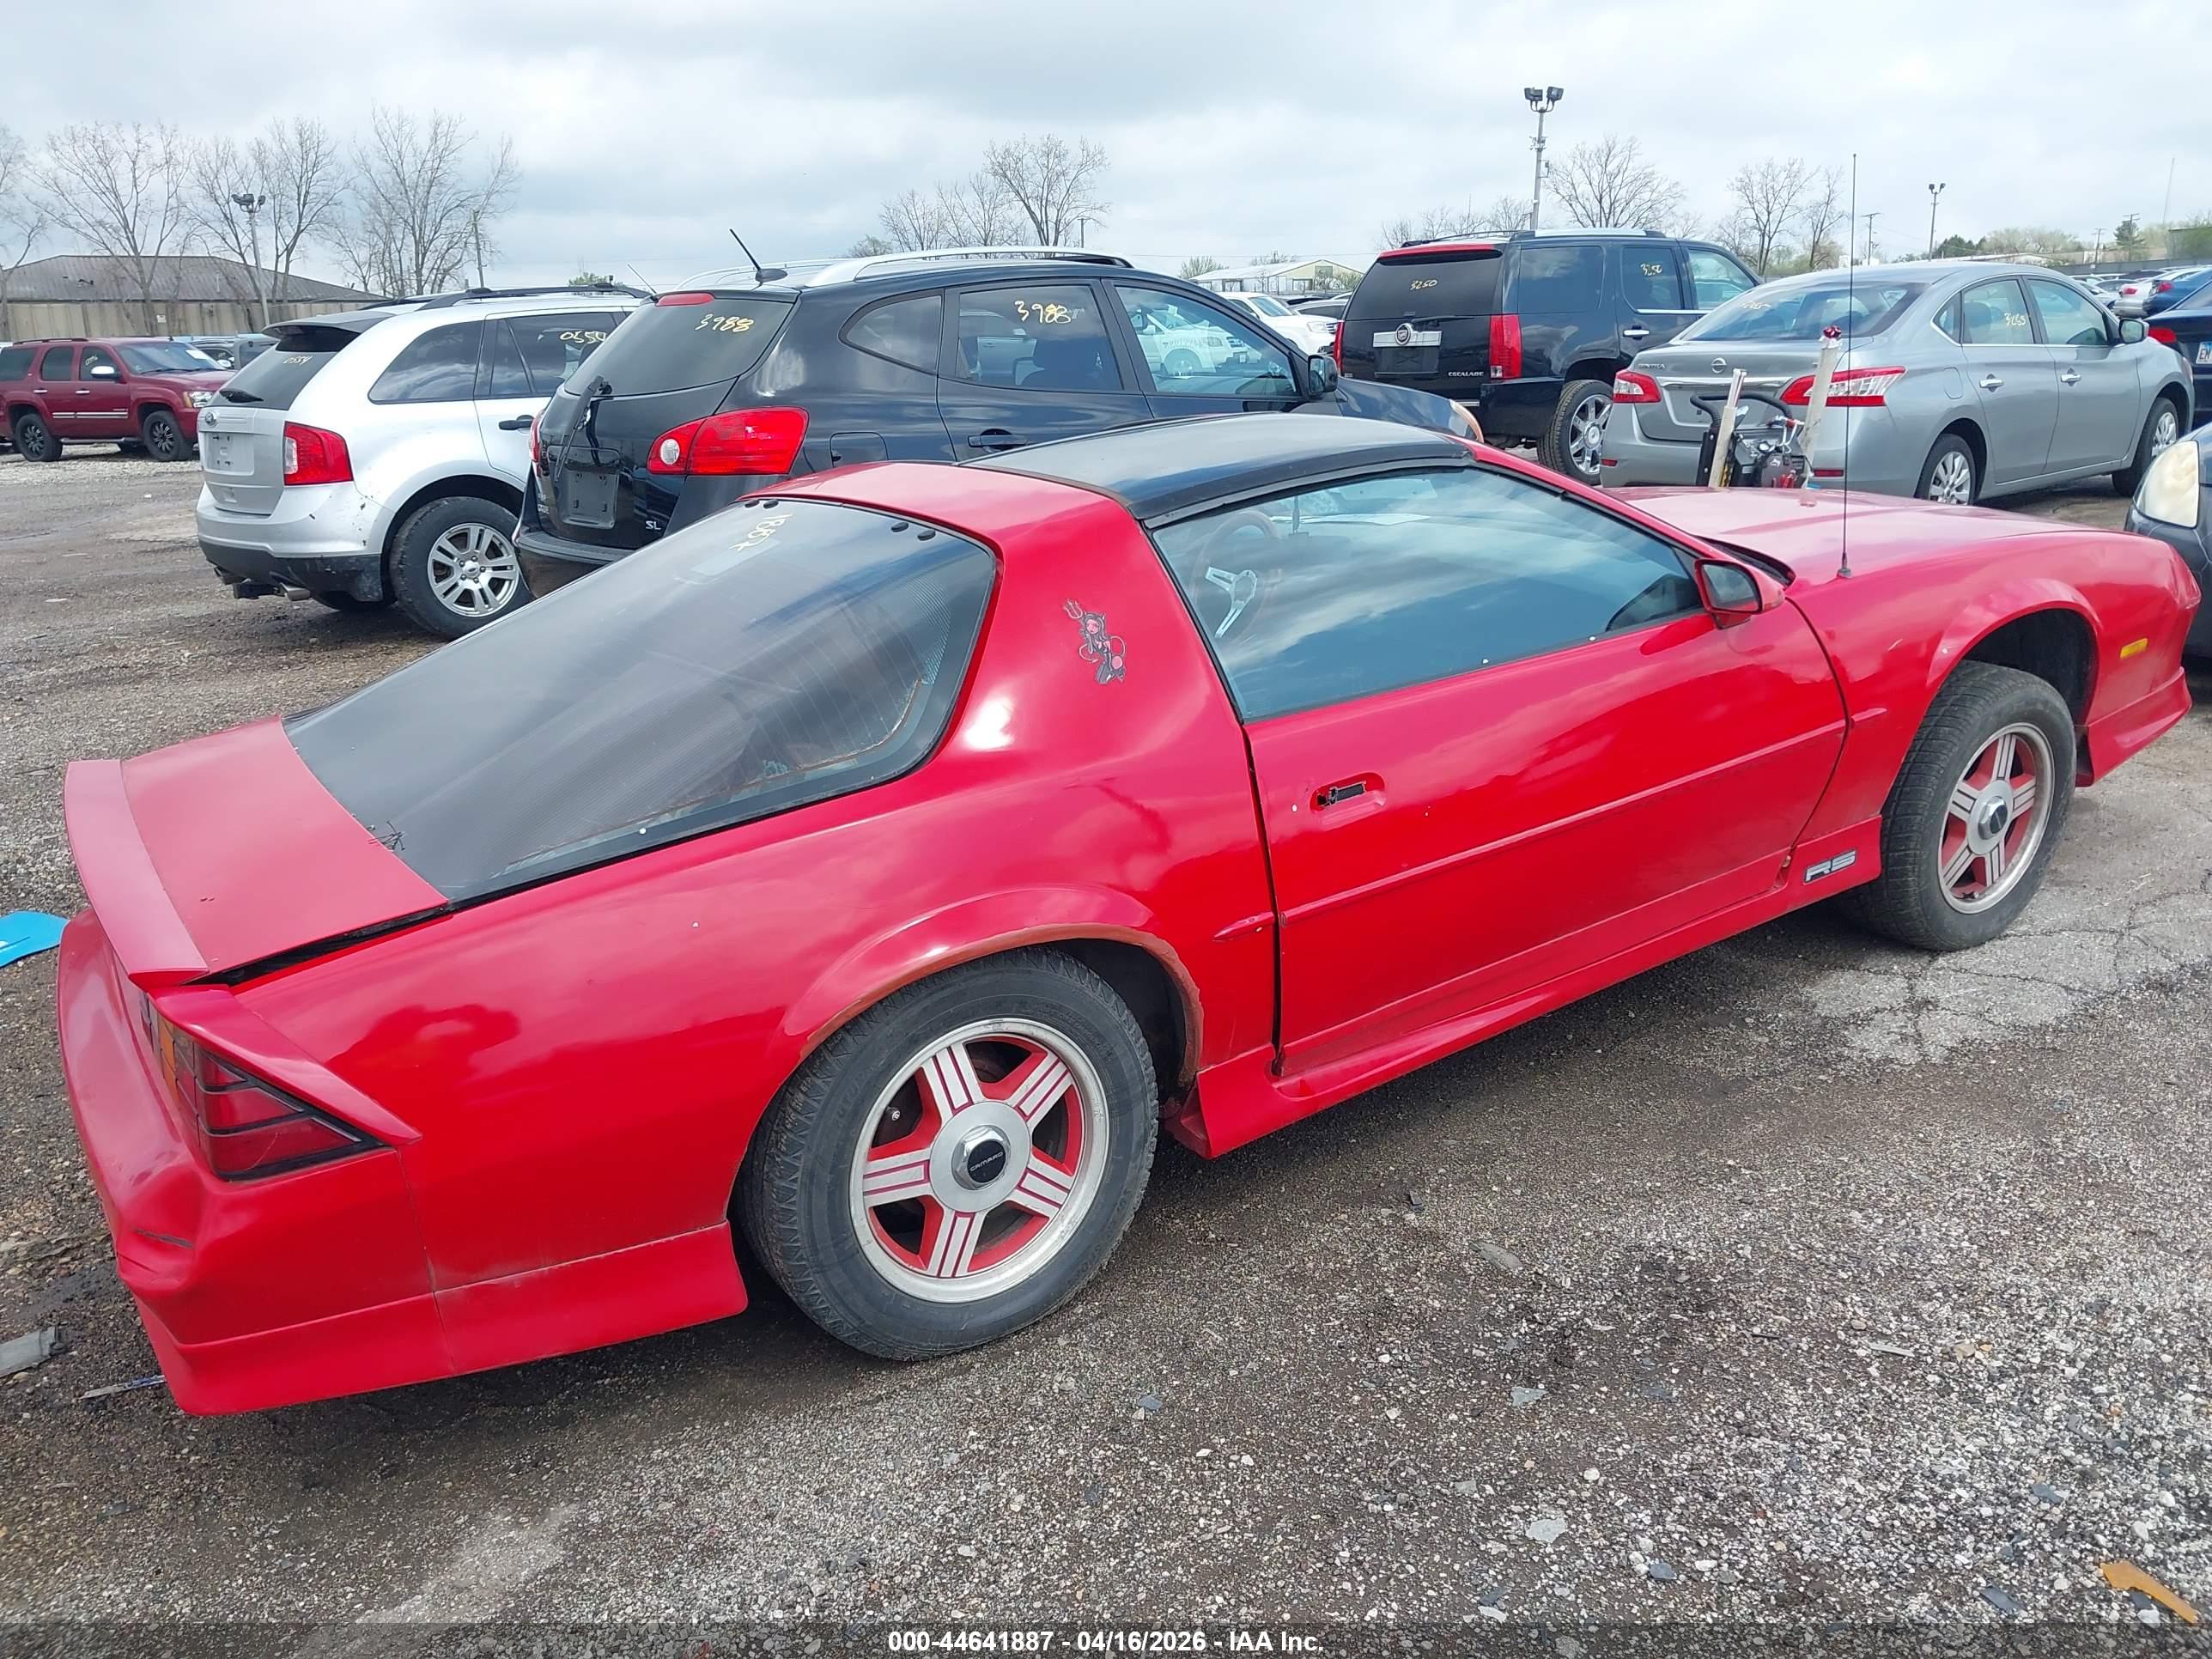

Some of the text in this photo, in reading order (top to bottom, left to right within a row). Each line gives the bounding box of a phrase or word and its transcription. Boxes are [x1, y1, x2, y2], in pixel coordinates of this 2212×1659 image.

[1410, 279, 1437, 290] 3250
[1014, 301, 1072, 324] 3988
[695, 313, 754, 332] 3988
[645, 520, 662, 531] SL
[1805, 849, 1856, 883] RS
[970, 1152, 1004, 1171] CAMARO
